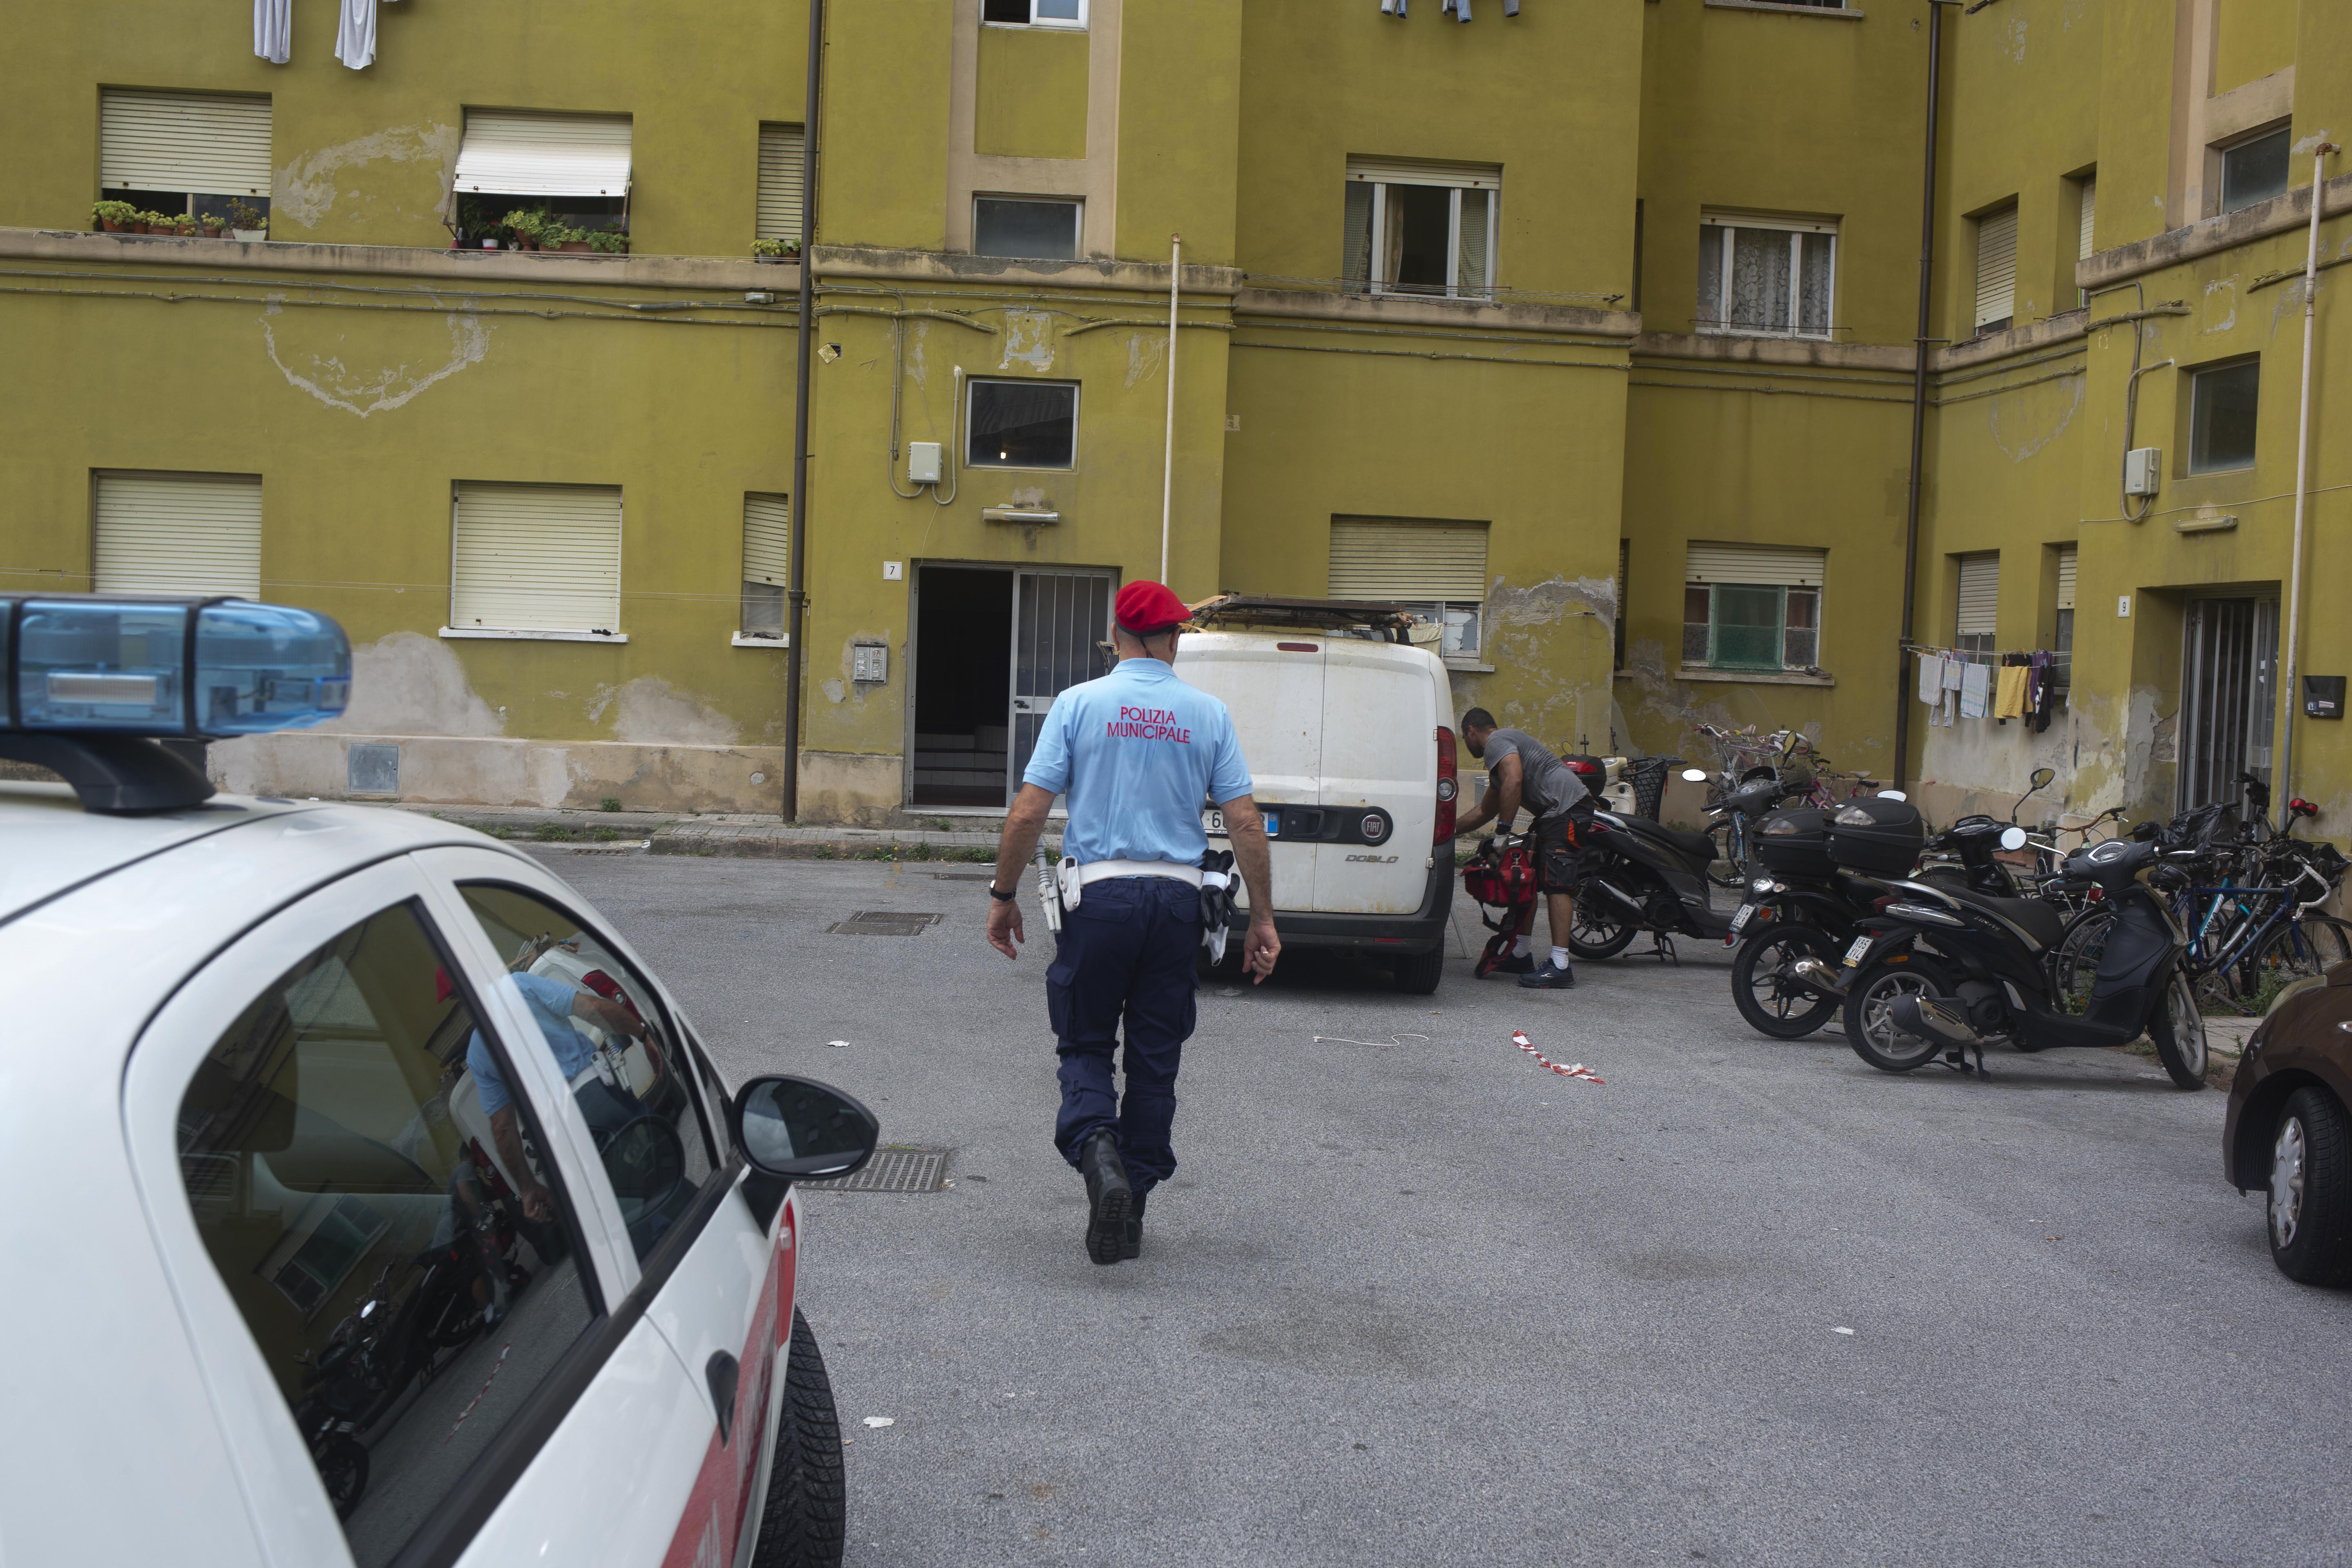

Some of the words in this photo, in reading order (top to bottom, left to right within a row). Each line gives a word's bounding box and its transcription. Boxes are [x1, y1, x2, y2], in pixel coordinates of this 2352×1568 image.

[890, 566, 895, 575] 7
[2123, 601, 2126, 612] 9
[1121, 706, 1176, 725] POLIZIA
[1107, 722, 1190, 744] MUNICIPALE
[1367, 821, 1380, 832] FIAT
[1854, 938, 1869, 949] X85
